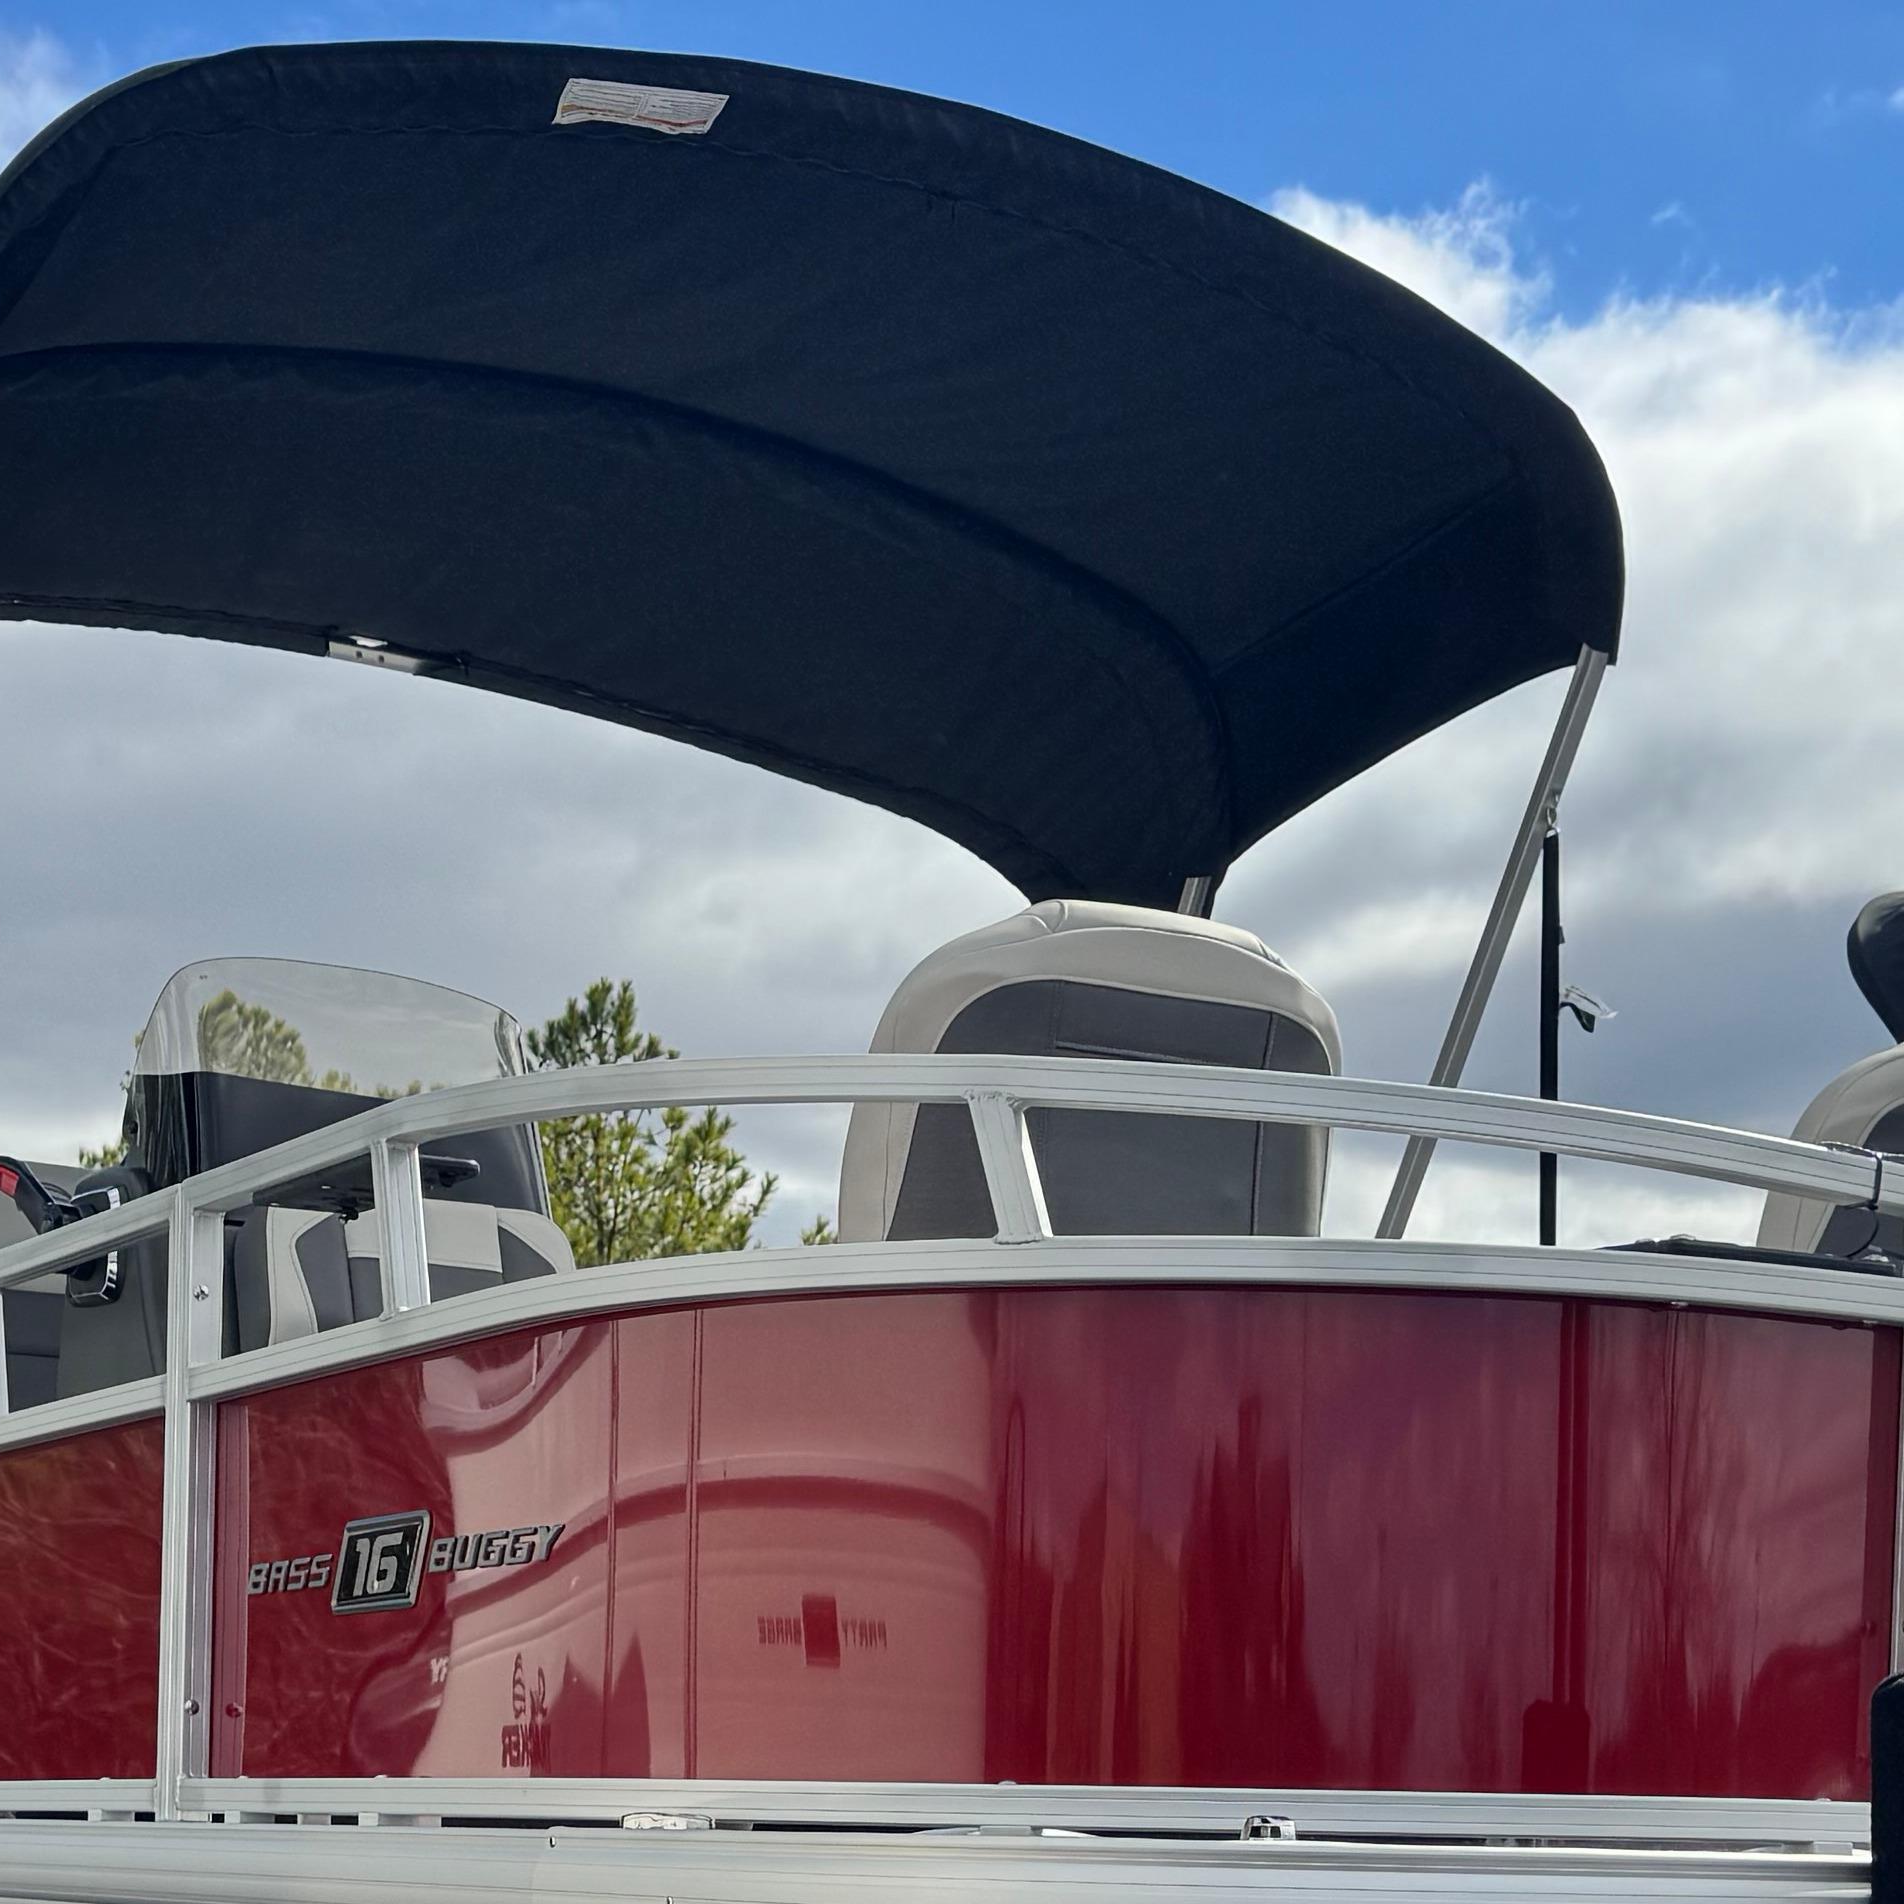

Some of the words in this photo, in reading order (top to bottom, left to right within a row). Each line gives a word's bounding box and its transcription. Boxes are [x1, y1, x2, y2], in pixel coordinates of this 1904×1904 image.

[247, 1553, 334, 1595] BASS
[352, 1532, 404, 1597] 16
[428, 1523, 566, 1574] BUGGY
